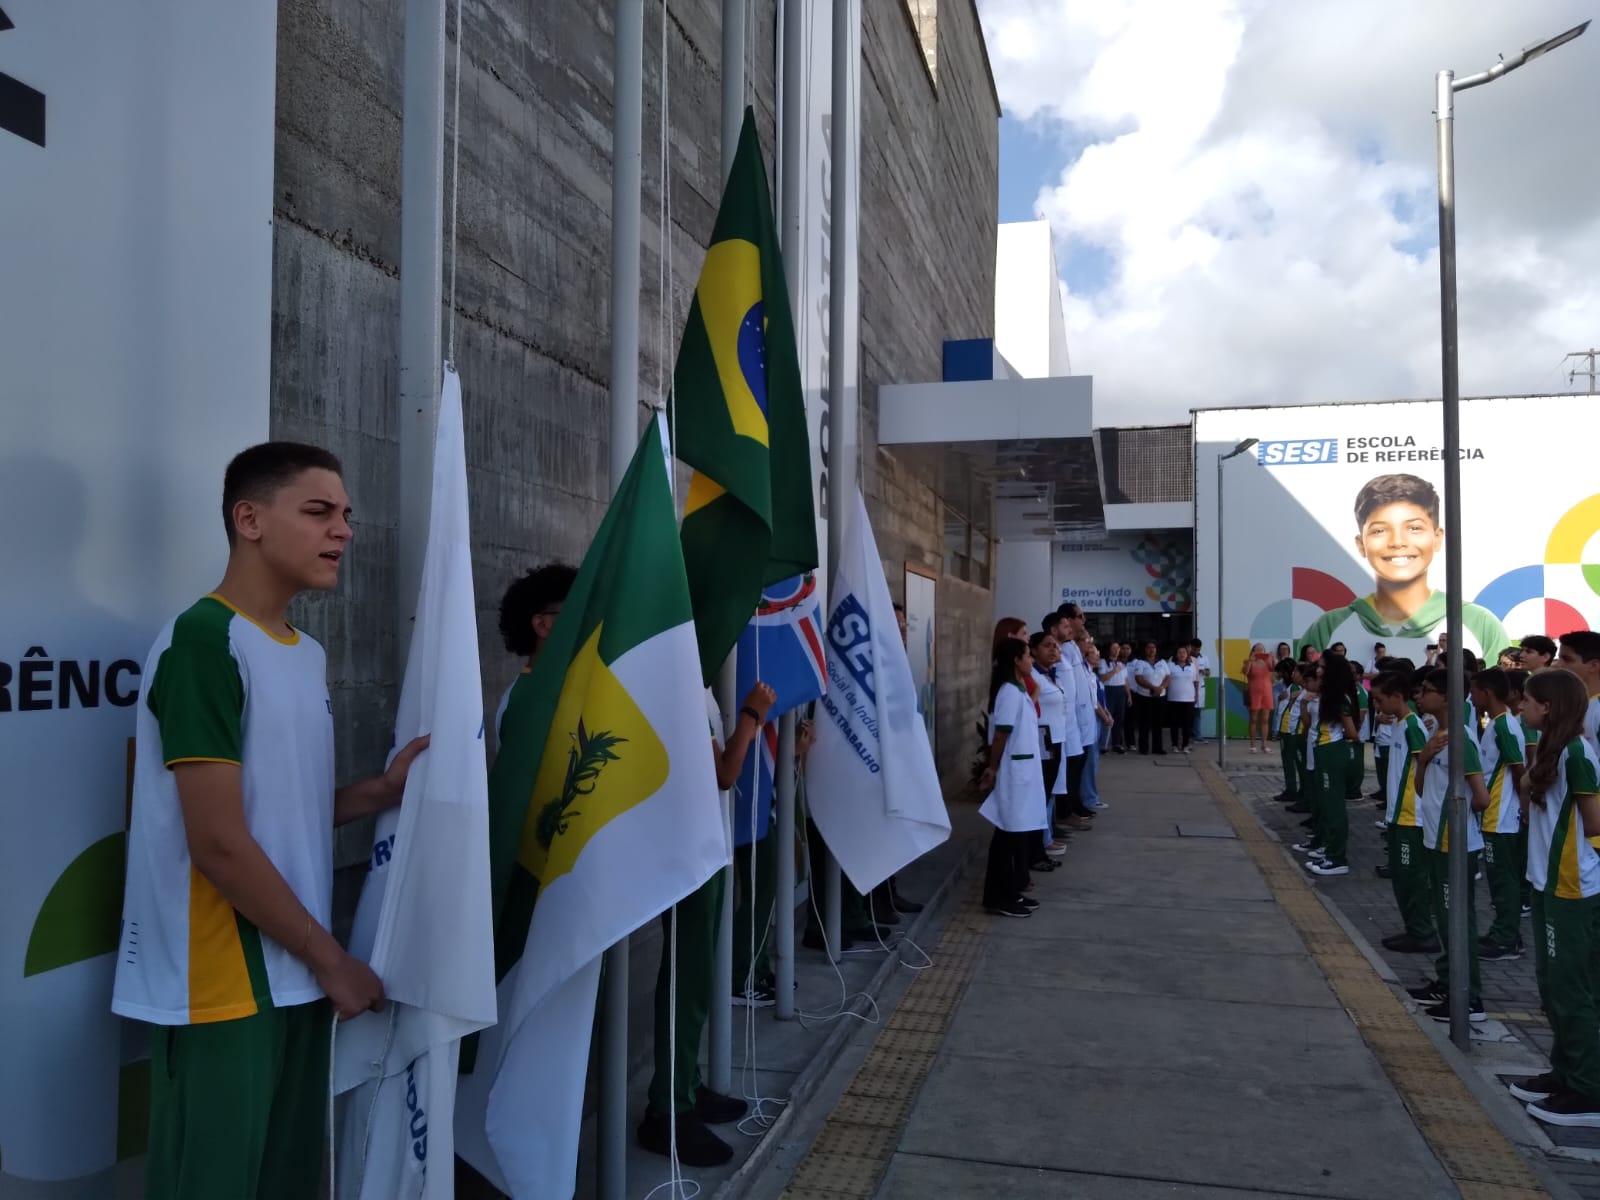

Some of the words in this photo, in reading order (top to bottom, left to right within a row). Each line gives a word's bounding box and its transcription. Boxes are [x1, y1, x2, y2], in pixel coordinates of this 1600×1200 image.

[1264, 441, 1332, 464] SESI
[1346, 435, 1416, 449] ESCOLA
[1346, 451, 1369, 464] DE
[1375, 446, 1485, 463] REFERÊCIA
[1062, 588, 1131, 598] Bem-vindo
[1081, 599, 1102, 607] seu
[1105, 598, 1144, 608] futuro
[826, 660, 848, 693] Social
[846, 689, 859, 707] da
[836, 714, 881, 774] TRABALHO
[1401, 842, 1410, 865] SESI
[1485, 841, 1494, 864] SESI
[1545, 923, 1556, 958] SESI
